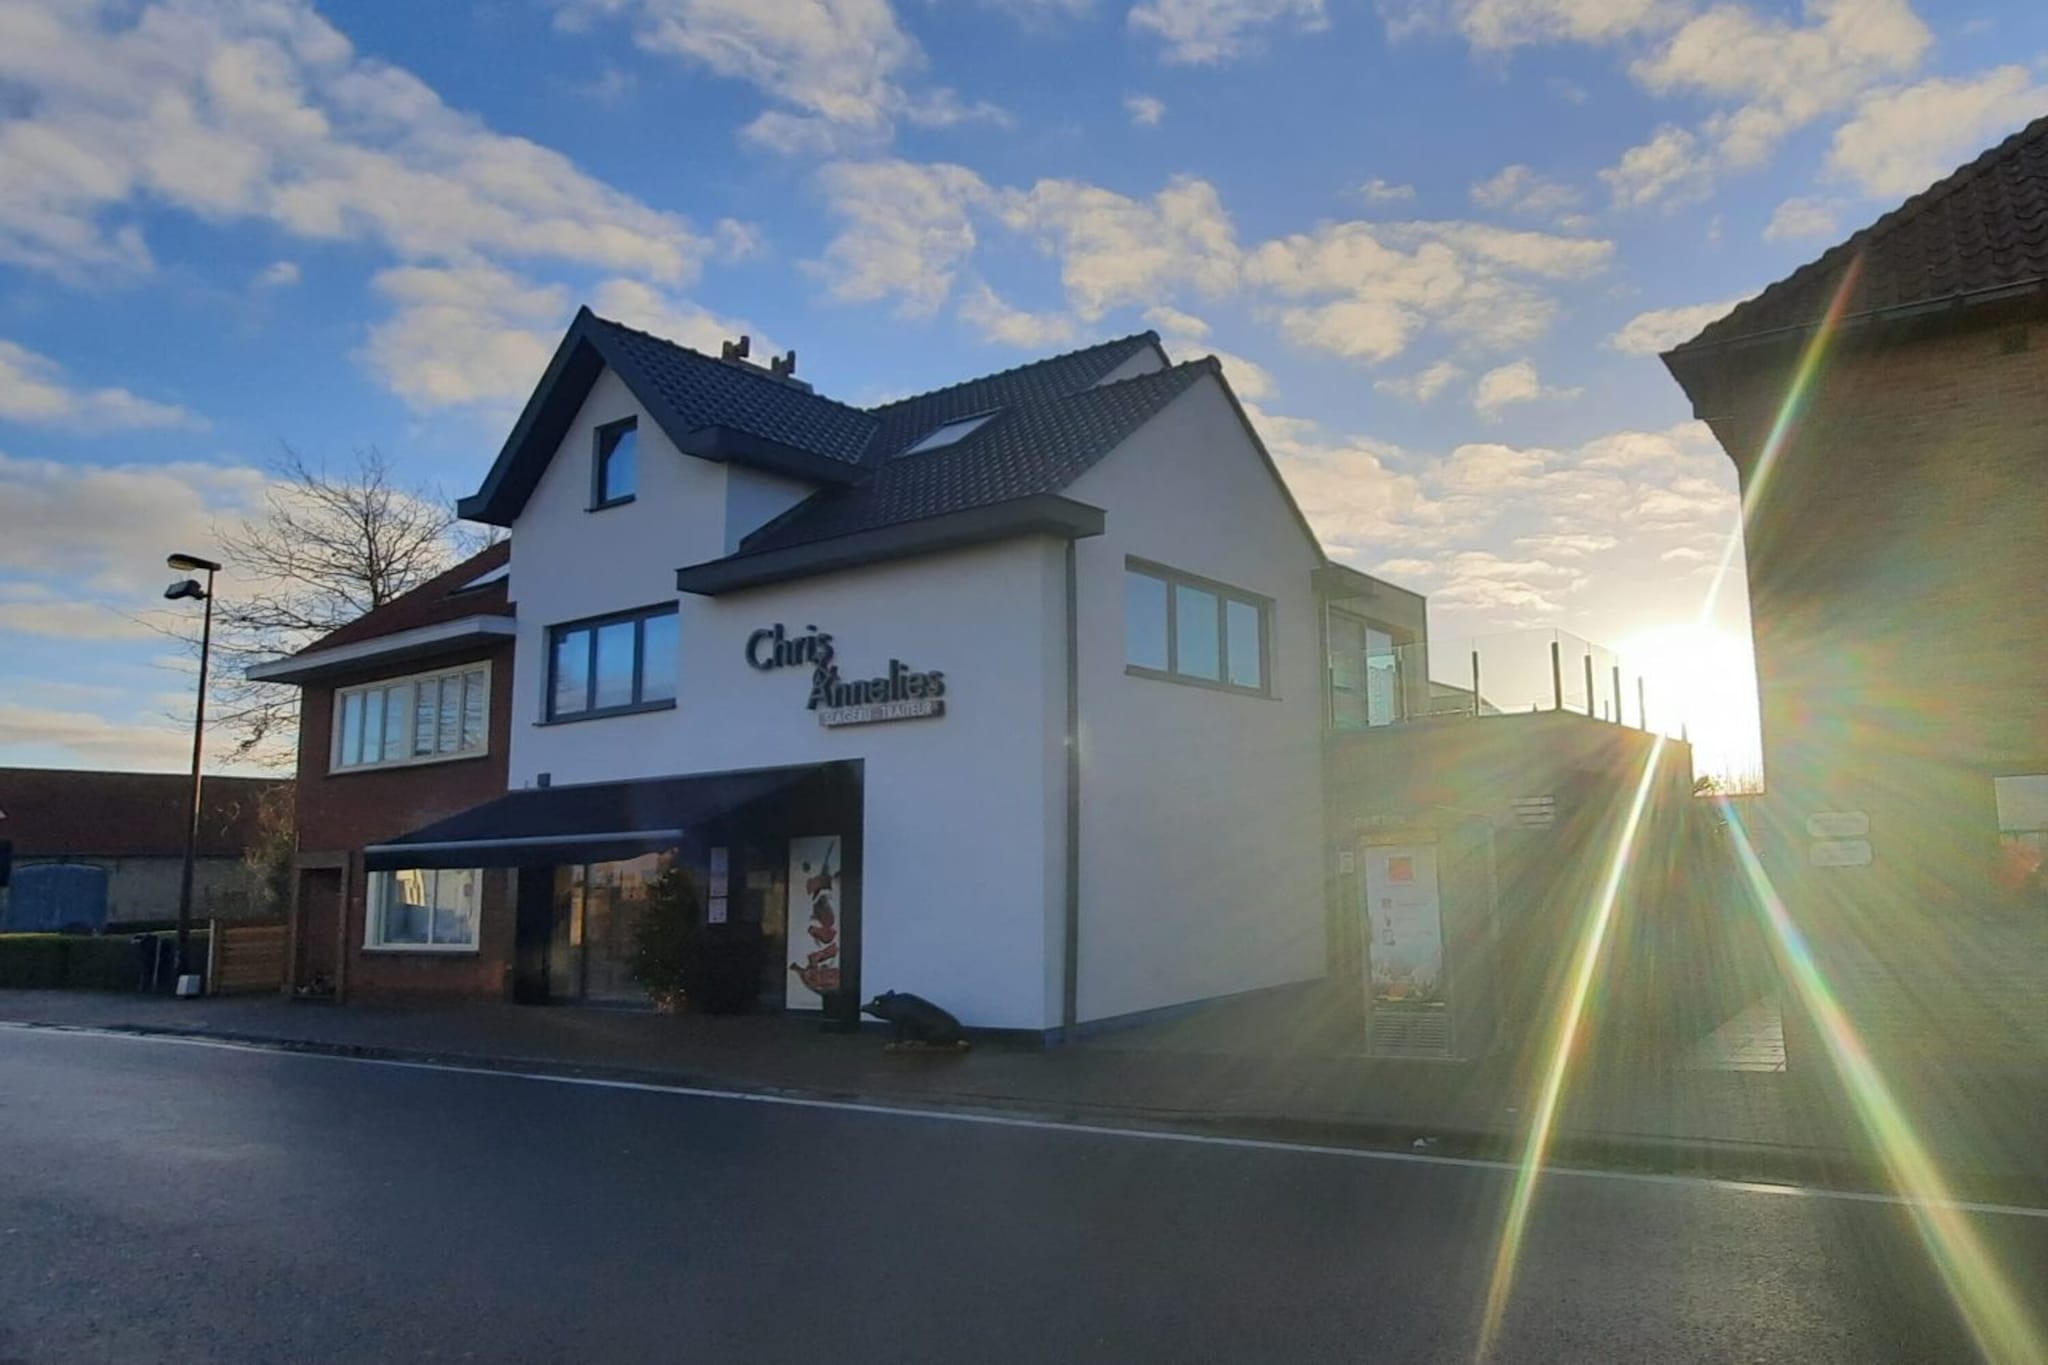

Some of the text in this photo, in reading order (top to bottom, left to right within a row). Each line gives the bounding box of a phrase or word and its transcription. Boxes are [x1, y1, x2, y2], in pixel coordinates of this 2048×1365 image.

[746, 623, 834, 670] Chris
[807, 659, 945, 709] Annelies
[881, 702, 932, 719] TRAITEUR
